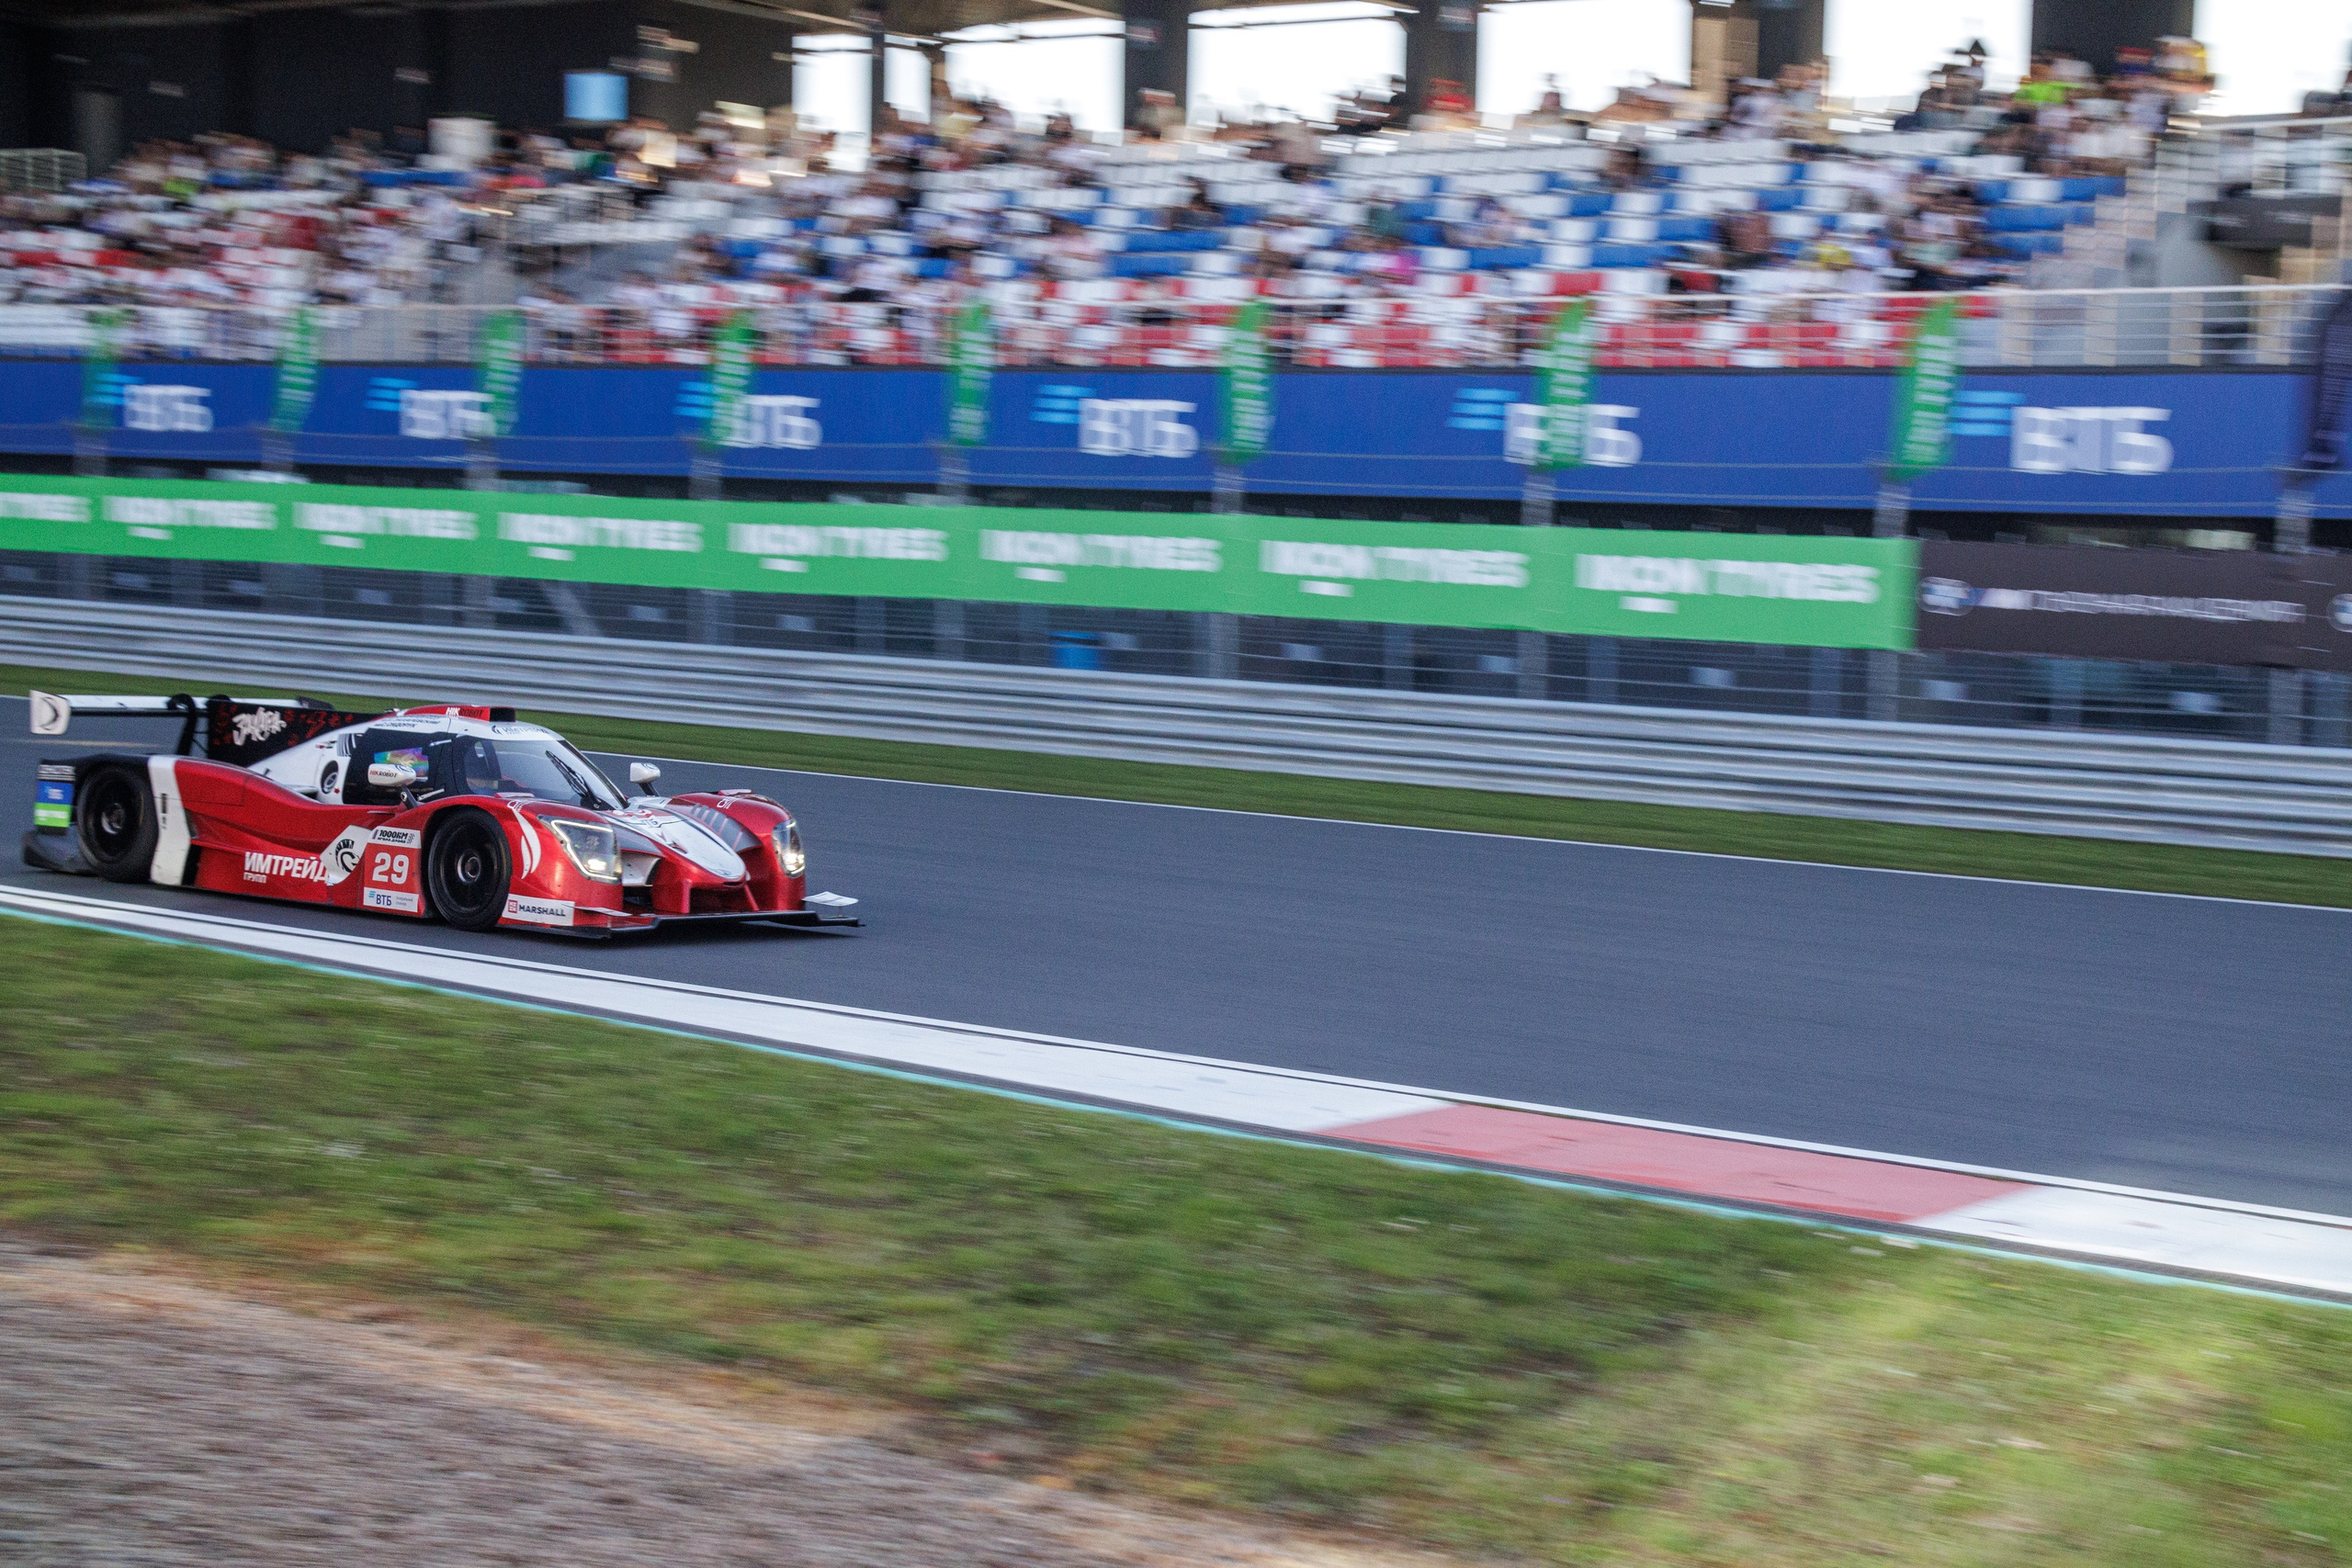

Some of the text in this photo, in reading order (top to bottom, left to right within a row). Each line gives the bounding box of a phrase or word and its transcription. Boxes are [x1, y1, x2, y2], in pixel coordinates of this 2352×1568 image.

[243, 852, 329, 883] ИМТРЕЙД
[371, 852, 410, 885] 29
[376, 893, 392, 907] ВТБ
[518, 904, 566, 918] MARSHALL
